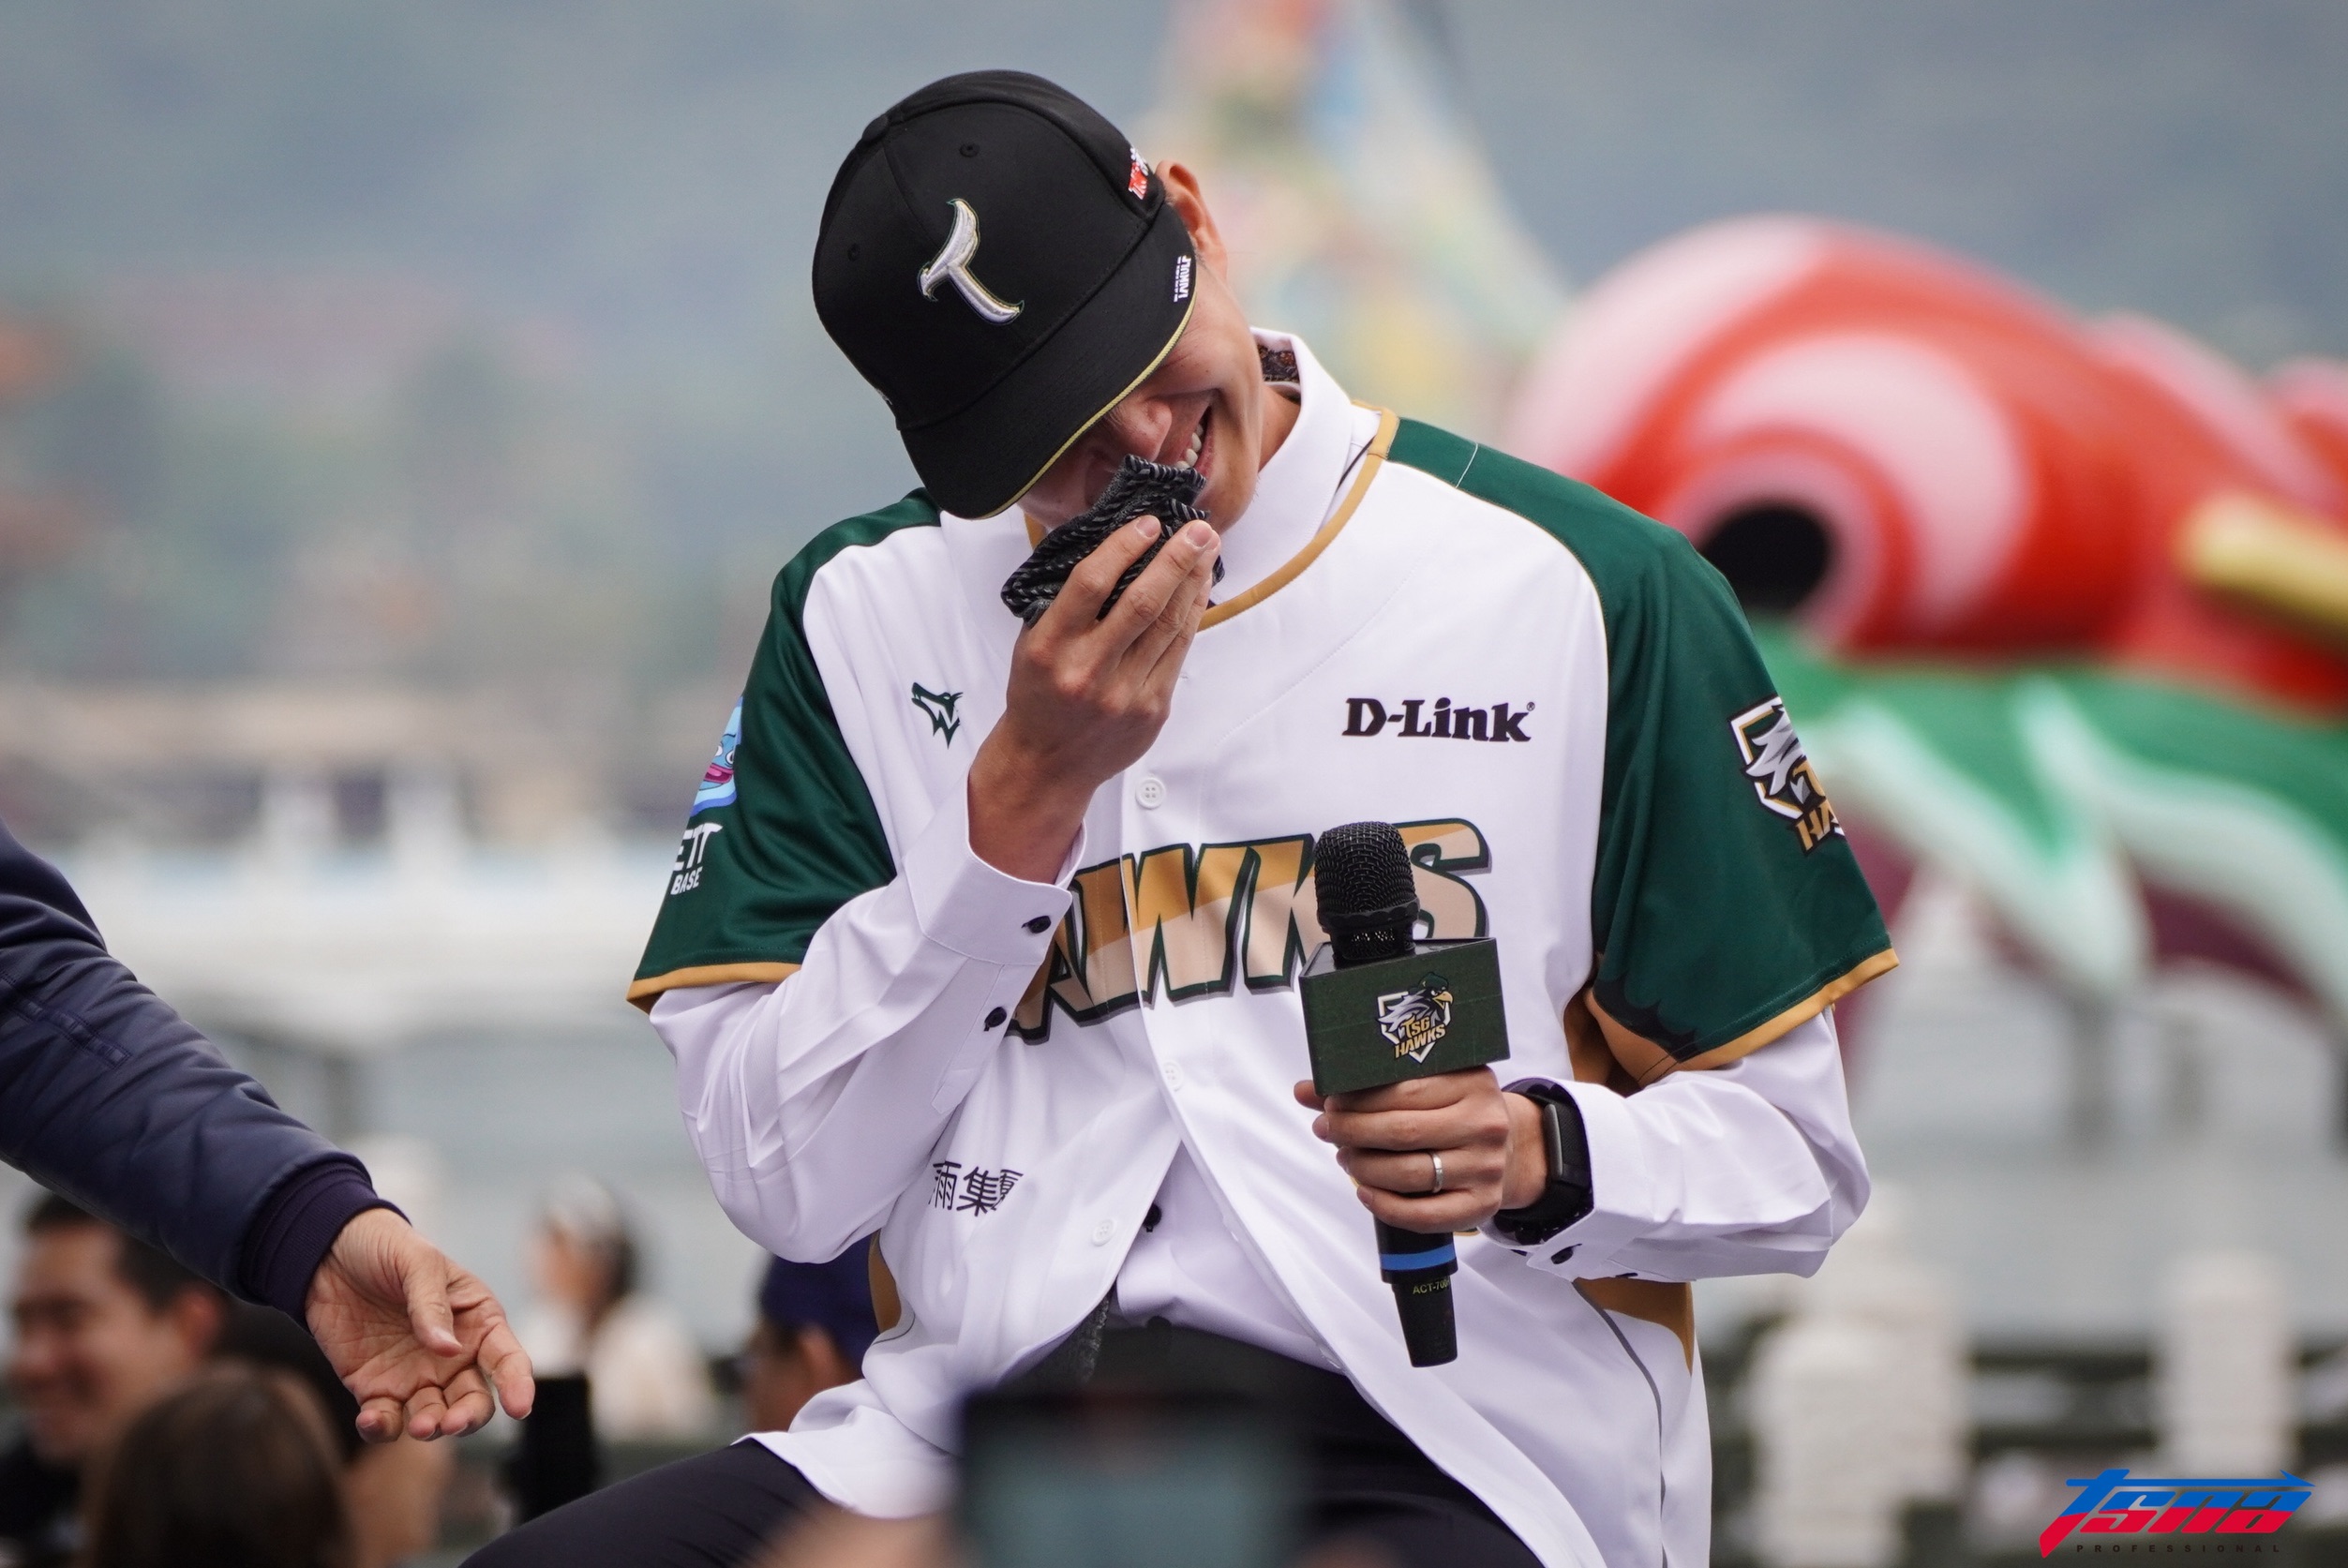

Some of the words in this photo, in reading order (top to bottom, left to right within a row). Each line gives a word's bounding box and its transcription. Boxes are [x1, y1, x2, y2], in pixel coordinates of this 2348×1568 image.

[670, 866, 703, 895] BASE
[1395, 1023, 1446, 1059] HAWKS
[1400, 1015, 1430, 1038] TSG
